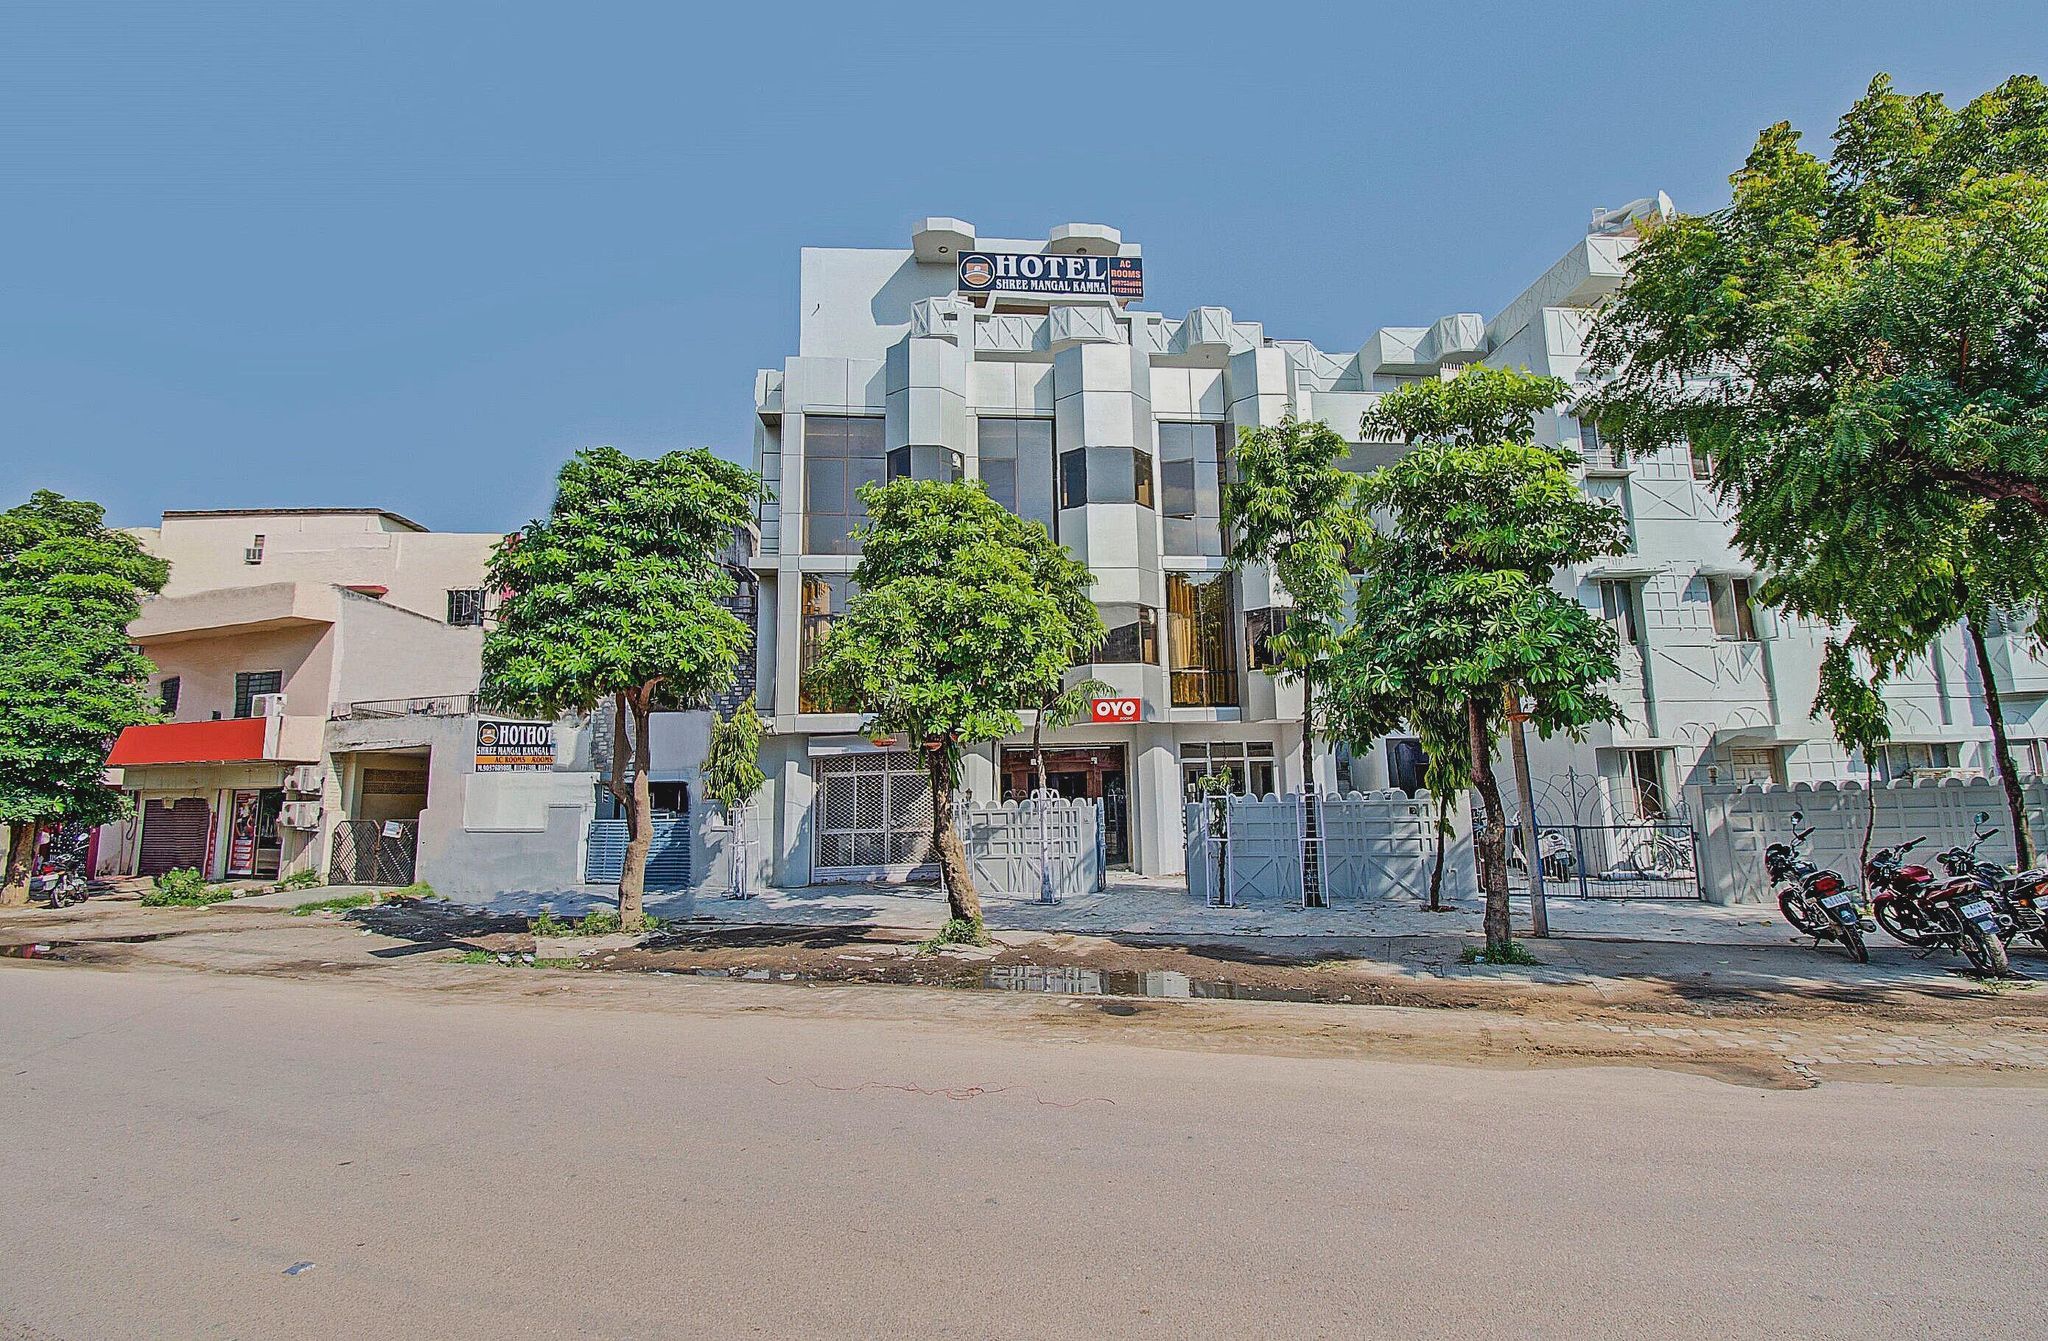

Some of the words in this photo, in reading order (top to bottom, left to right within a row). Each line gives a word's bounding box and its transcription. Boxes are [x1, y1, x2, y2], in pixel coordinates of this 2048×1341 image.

[995, 255, 1107, 280] HOTEL
[1119, 260, 1131, 268] AC
[1110, 269, 1141, 278] ROOMS
[996, 279, 1029, 290] SHREE
[1030, 280, 1071, 292] MANGAL
[1073, 281, 1107, 293] KAMNA
[1096, 701, 1135, 716] OYO
